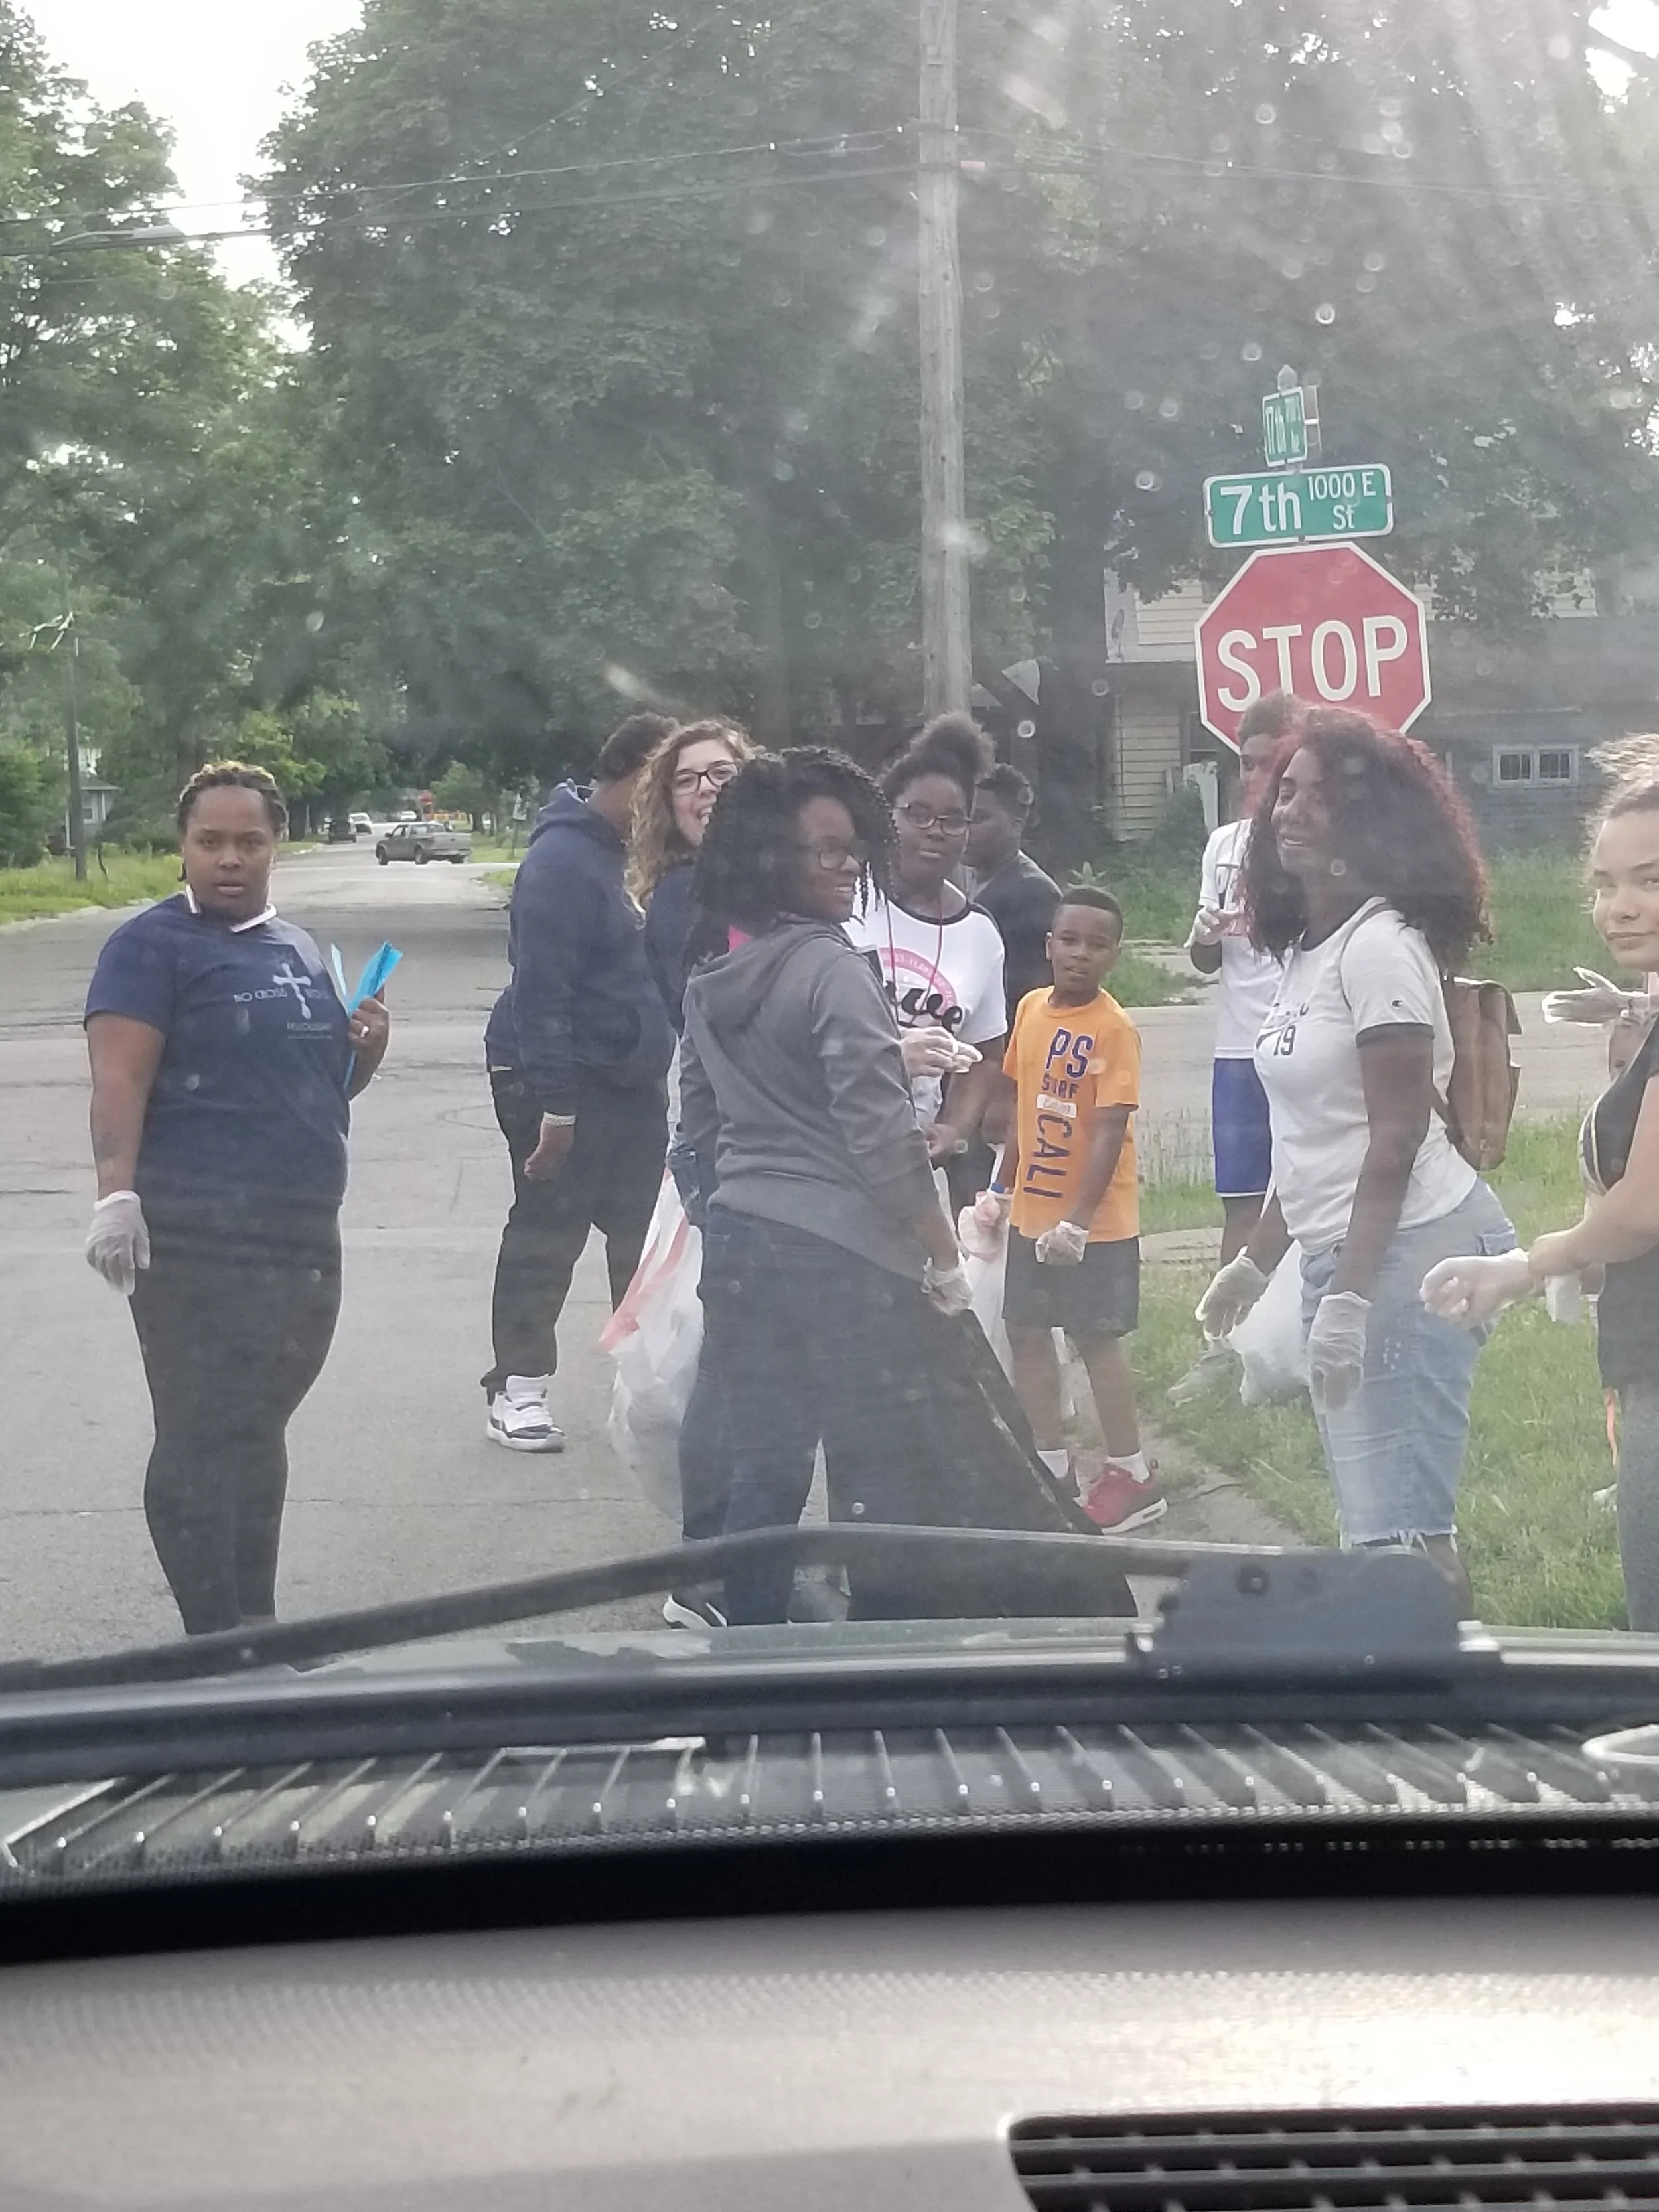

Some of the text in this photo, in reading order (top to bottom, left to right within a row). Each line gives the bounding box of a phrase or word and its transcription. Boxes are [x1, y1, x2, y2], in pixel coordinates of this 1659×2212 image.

[1220, 471, 1376, 534] 7th 1000 E
[1333, 505, 1355, 530] St
[1217, 615, 1407, 713] STOP
[1045, 1028, 1094, 1078] PS
[1023, 1114, 1072, 1199] CALI
